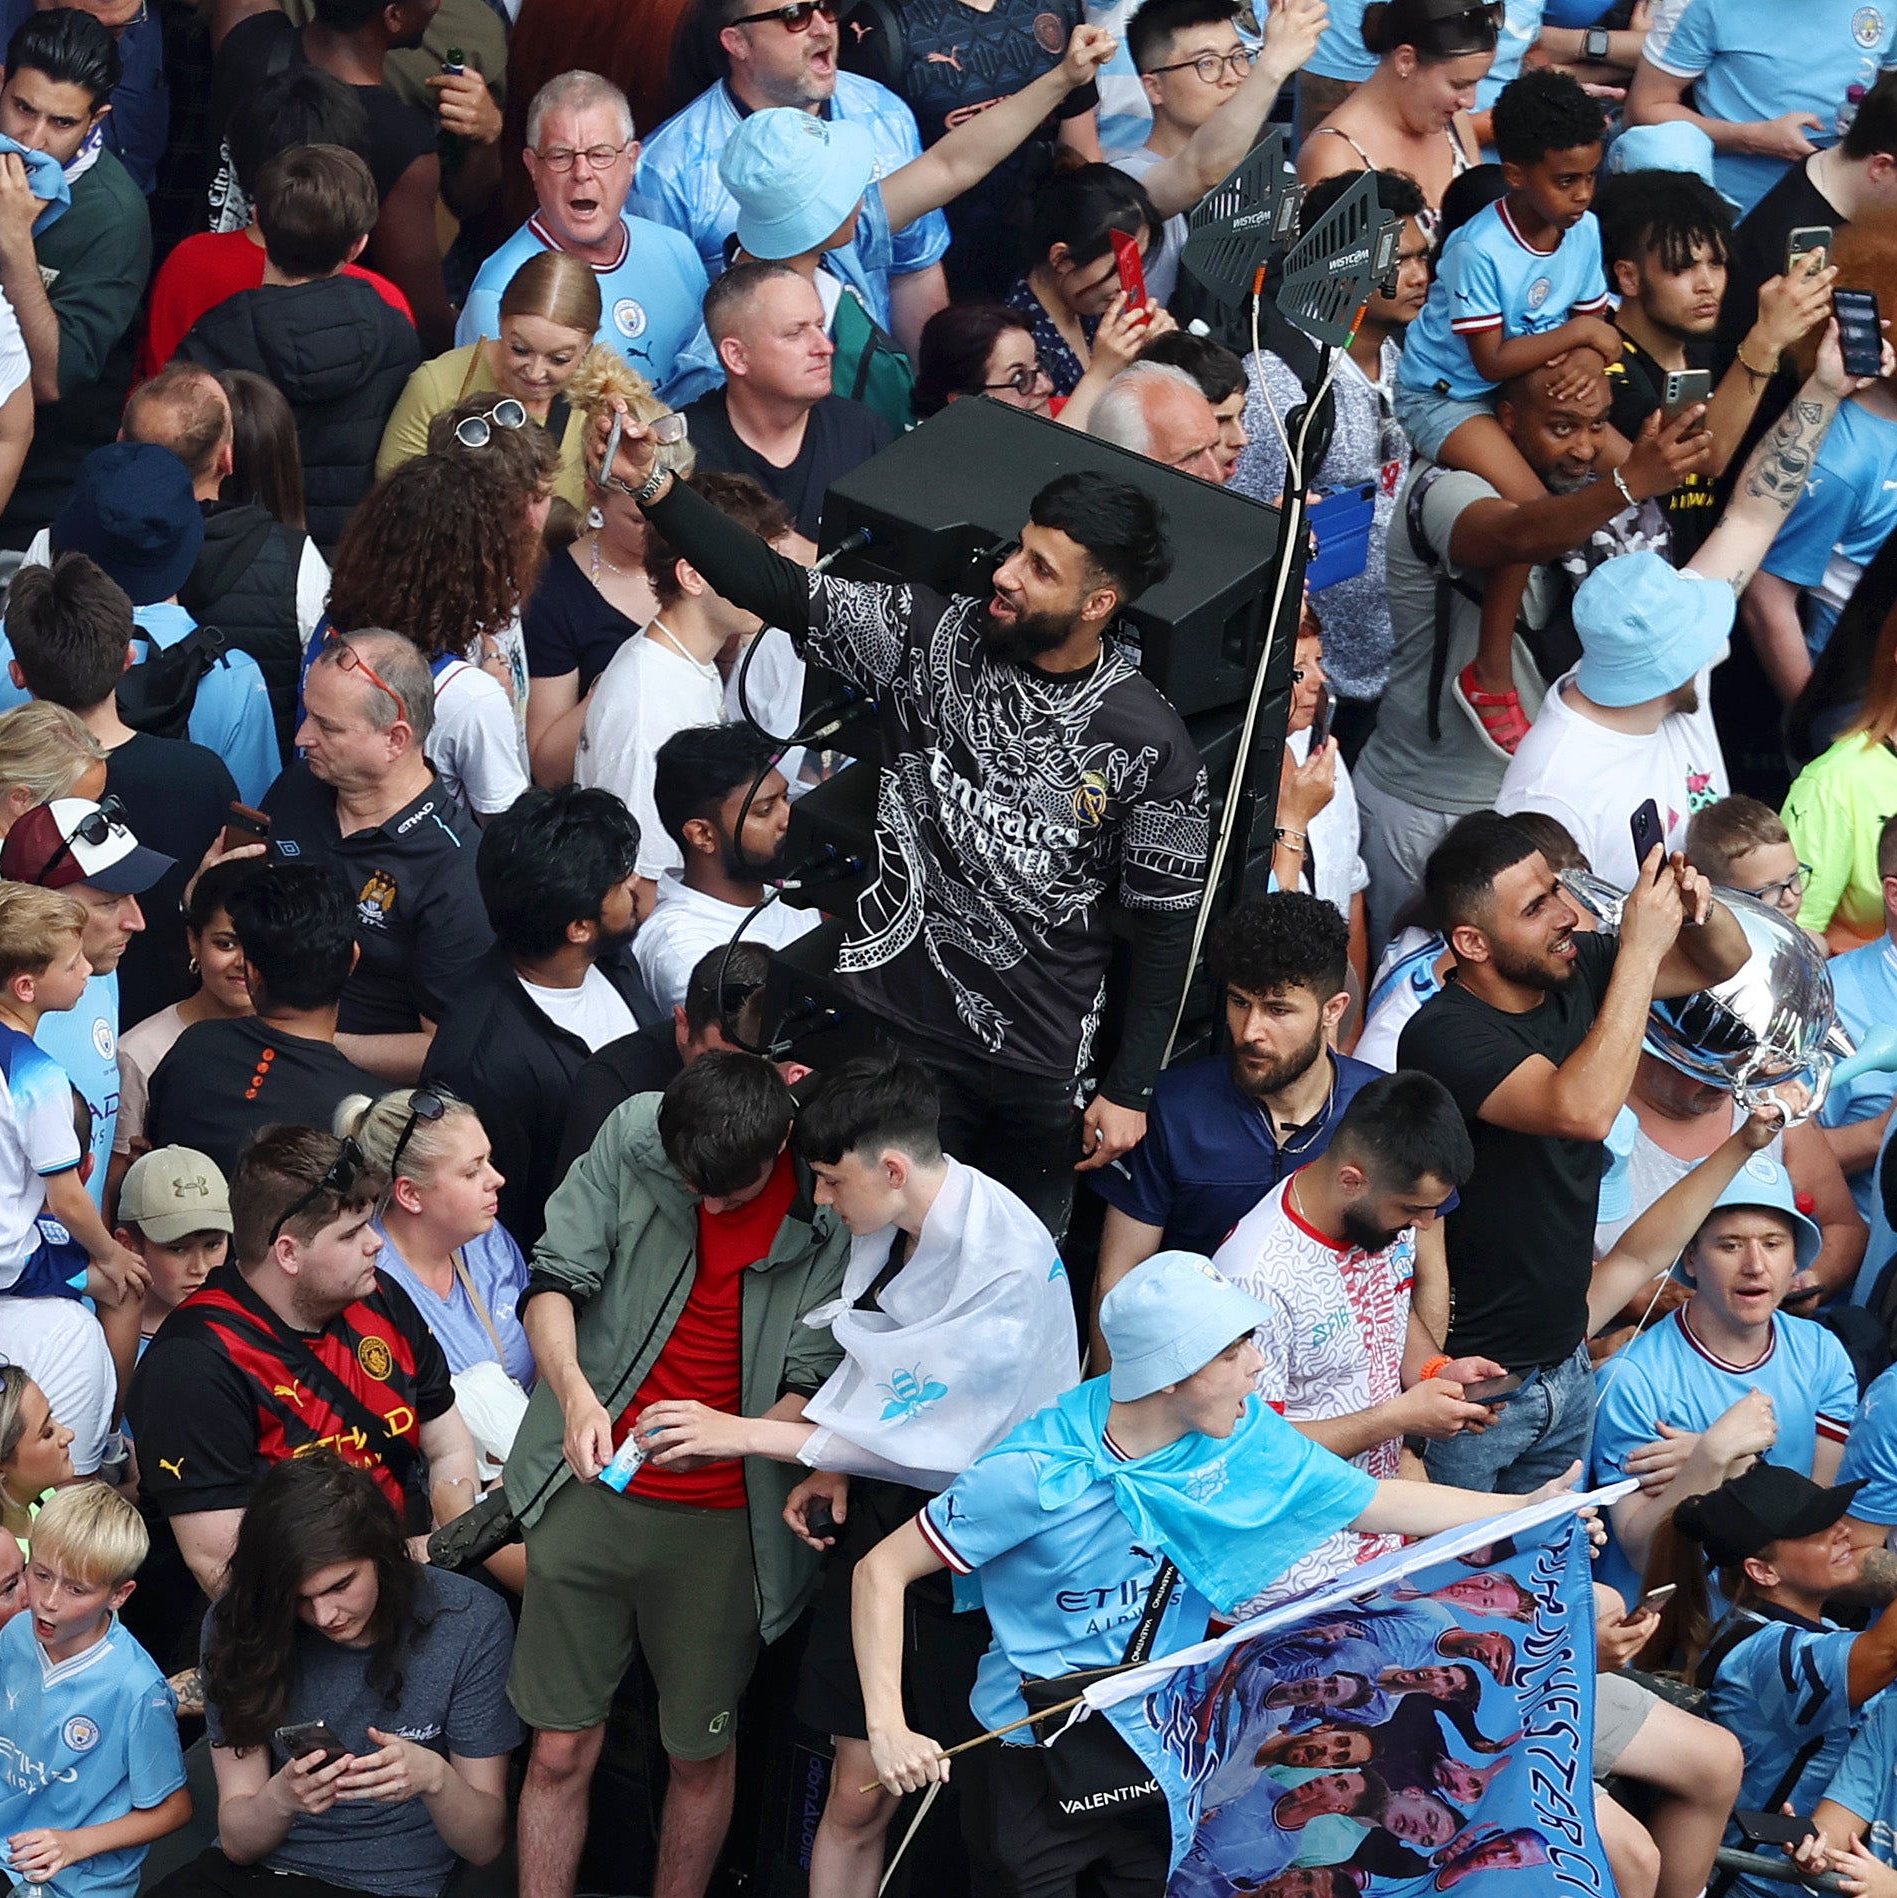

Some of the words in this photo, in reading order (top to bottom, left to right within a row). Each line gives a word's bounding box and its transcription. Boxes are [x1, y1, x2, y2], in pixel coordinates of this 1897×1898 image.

[397, 801, 434, 834] ETIHAD
[931, 746, 1081, 850] Emirates
[1151, 1566, 1173, 1610] VALENTINO
[1132, 1618, 1153, 1663] VALENTINO
[1512, 1526, 1584, 1844] MANCHESTER
